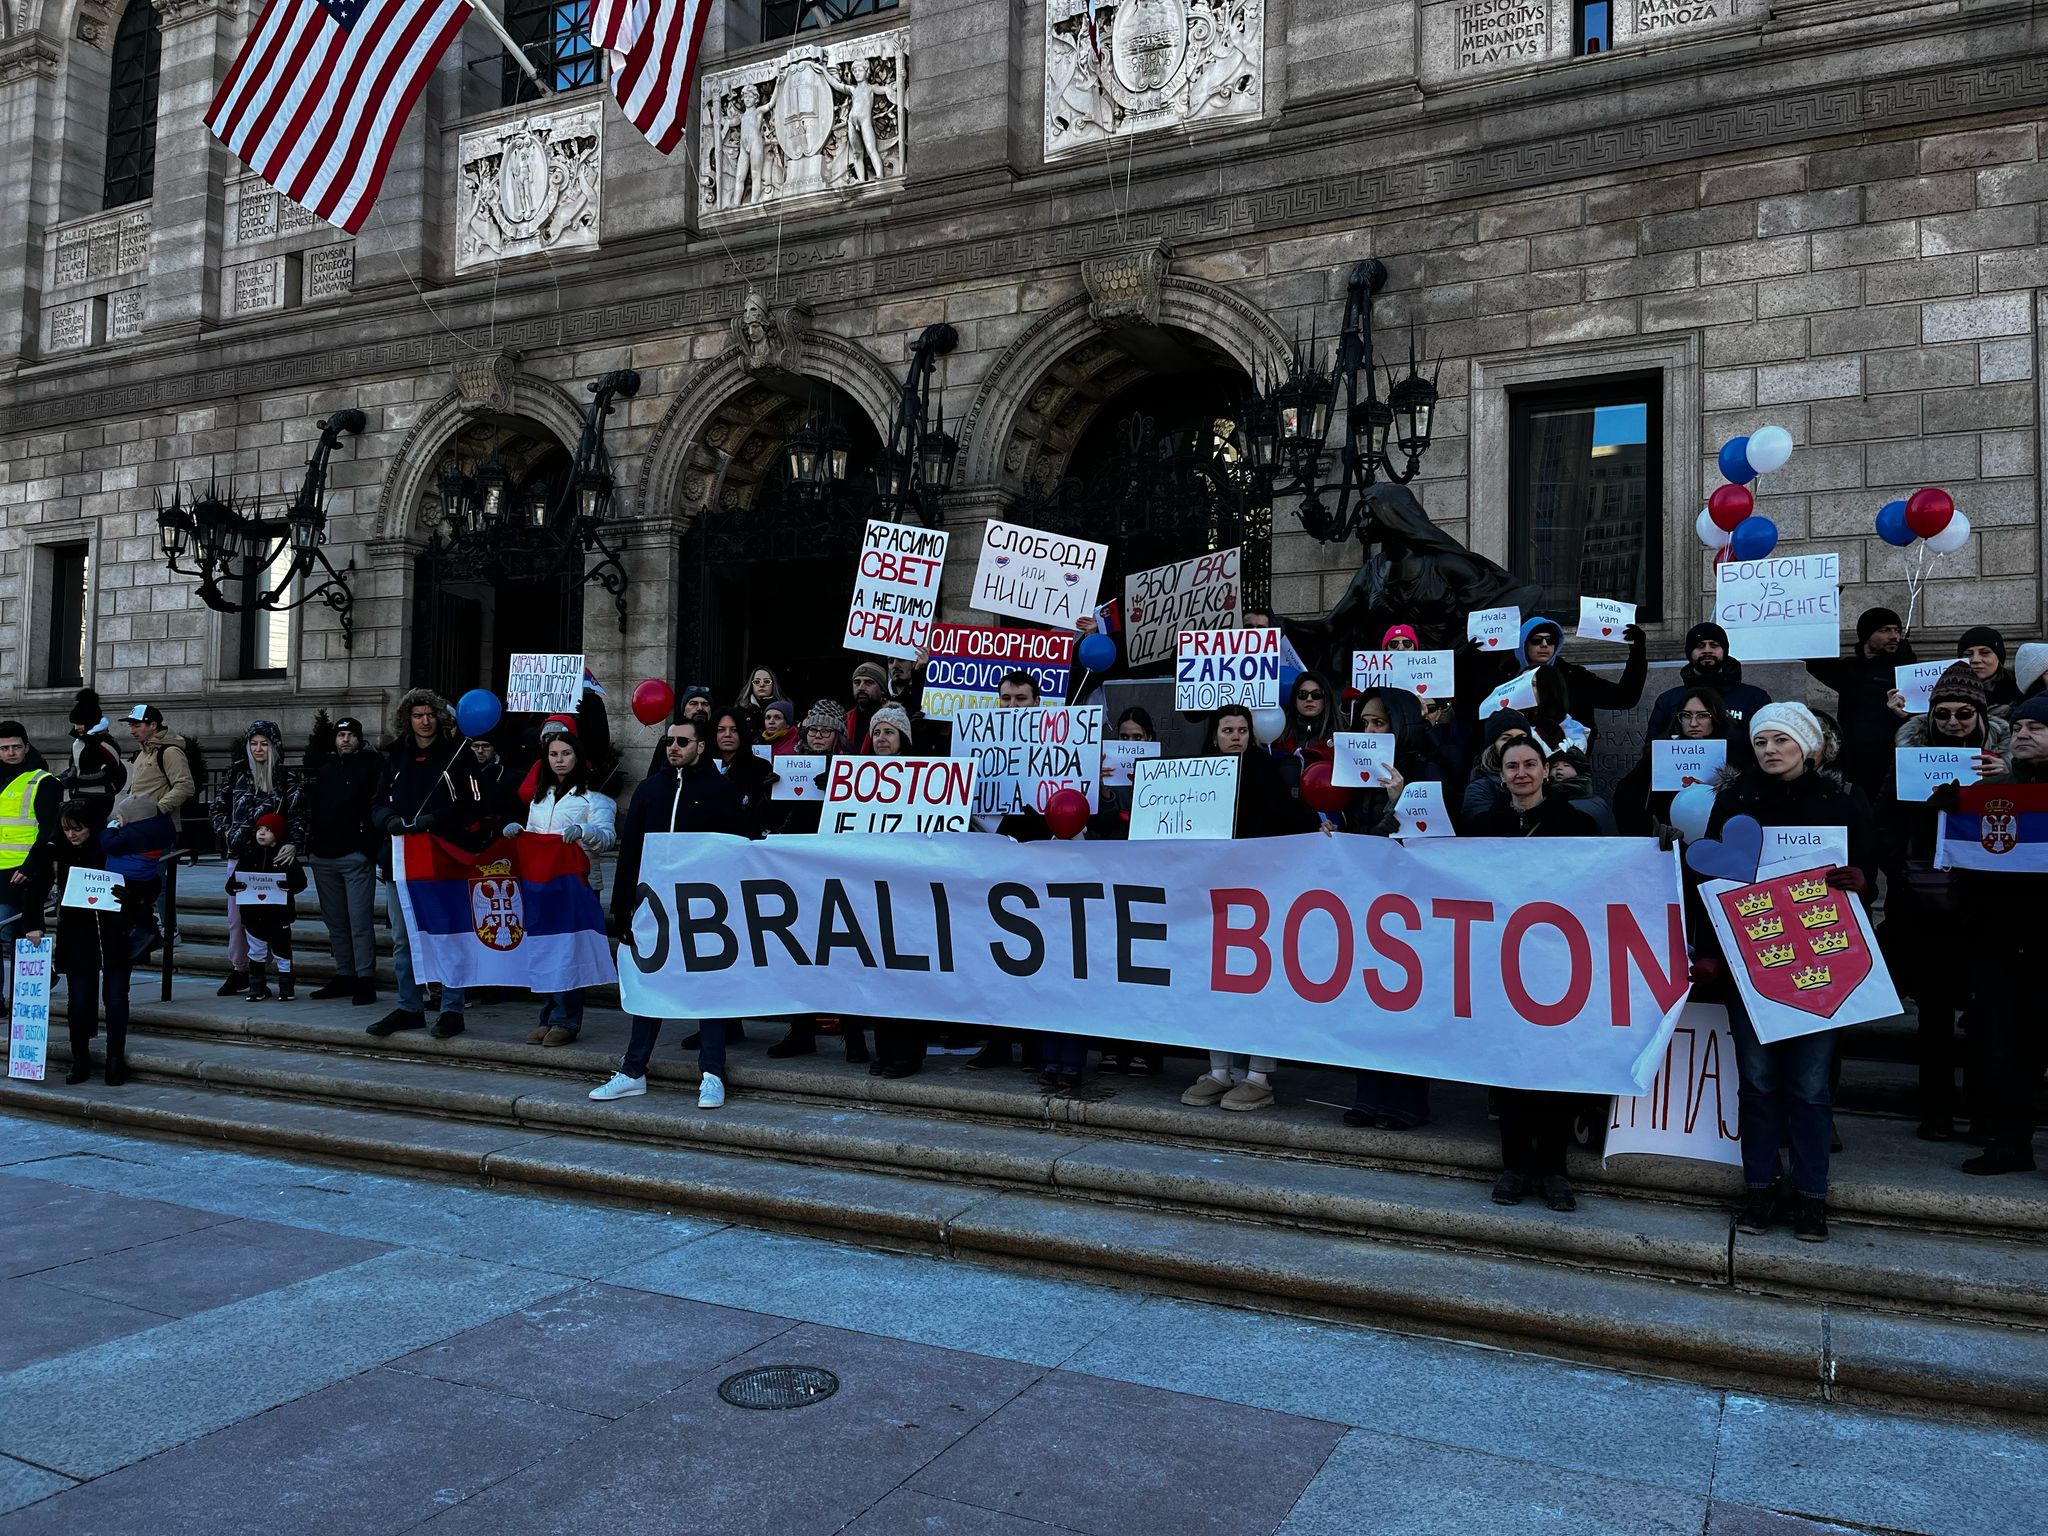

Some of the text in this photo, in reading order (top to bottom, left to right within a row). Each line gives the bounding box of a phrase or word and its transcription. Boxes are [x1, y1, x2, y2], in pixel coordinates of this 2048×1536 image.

[1640, 5, 1717, 31] SPINOZA
[1461, 23, 1545, 51] MENANDER
[789, 46, 812, 57] LVX
[1462, 40, 1537, 67] PLAVTVS
[241, 204, 270, 218] GIOTTO
[240, 225, 276, 240] GIORGIONE
[314, 270, 352, 285] SANGALLO
[237, 296, 268, 310] HOLBEIN
[865, 524, 944, 558] КРАСИМО
[987, 525, 1096, 570] СЛОБОДА
[861, 551, 941, 588] СВЕТ
[1136, 551, 1237, 600] ЗБОГ ВАС
[1722, 556, 1837, 583] БОСТОН ЈЕ
[853, 589, 933, 618] А ЖЕЛИМО
[1136, 582, 1233, 632] ДАЛЕКО
[1596, 602, 1622, 614] Hvala
[1722, 591, 1839, 622] СТУДЕНТЕ!
[1481, 612, 1507, 622] Hvala
[1598, 615, 1619, 625] vam
[849, 610, 930, 648] СРБИЈУ
[1483, 626, 1503, 635] vam
[930, 629, 1074, 660] ОДГОВОРНОСТ
[1130, 630, 1157, 664] ОД
[1179, 630, 1278, 656] PRAVDA
[1408, 656, 1437, 666] Hvala
[1178, 656, 1279, 683] ZAKON
[1411, 672, 1433, 680] vam
[1177, 682, 1276, 709] MORAL
[1920, 684, 1936, 693] va
[1073, 709, 1101, 745] SE
[1117, 746, 1145, 755] Hvala
[1348, 739, 1377, 750] Hvala
[1671, 745, 1705, 755] Hvala
[786, 760, 812, 769] Hvala
[1027, 746, 1082, 777] KADA
[1120, 761, 1135, 769] va
[1353, 757, 1372, 766] vam
[1919, 753, 1959, 763] Hvala
[1142, 759, 1236, 781] WARNING:
[1675, 762, 1700, 771] vam
[789, 775, 808, 783] vam
[1924, 771, 1954, 780] vam
[829, 761, 974, 805] BOSTON
[1138, 784, 1216, 814] Corruption
[1404, 788, 1428, 799] Hvala
[1405, 807, 1428, 816] vam
[1157, 810, 1193, 834] Kills
[1777, 833, 1822, 845] Hvala
[84, 872, 110, 882] Hvala
[249, 875, 273, 883] Hvala
[85, 885, 105, 893] vam
[630, 878, 1689, 1027] OBRALI STE BOSTON
